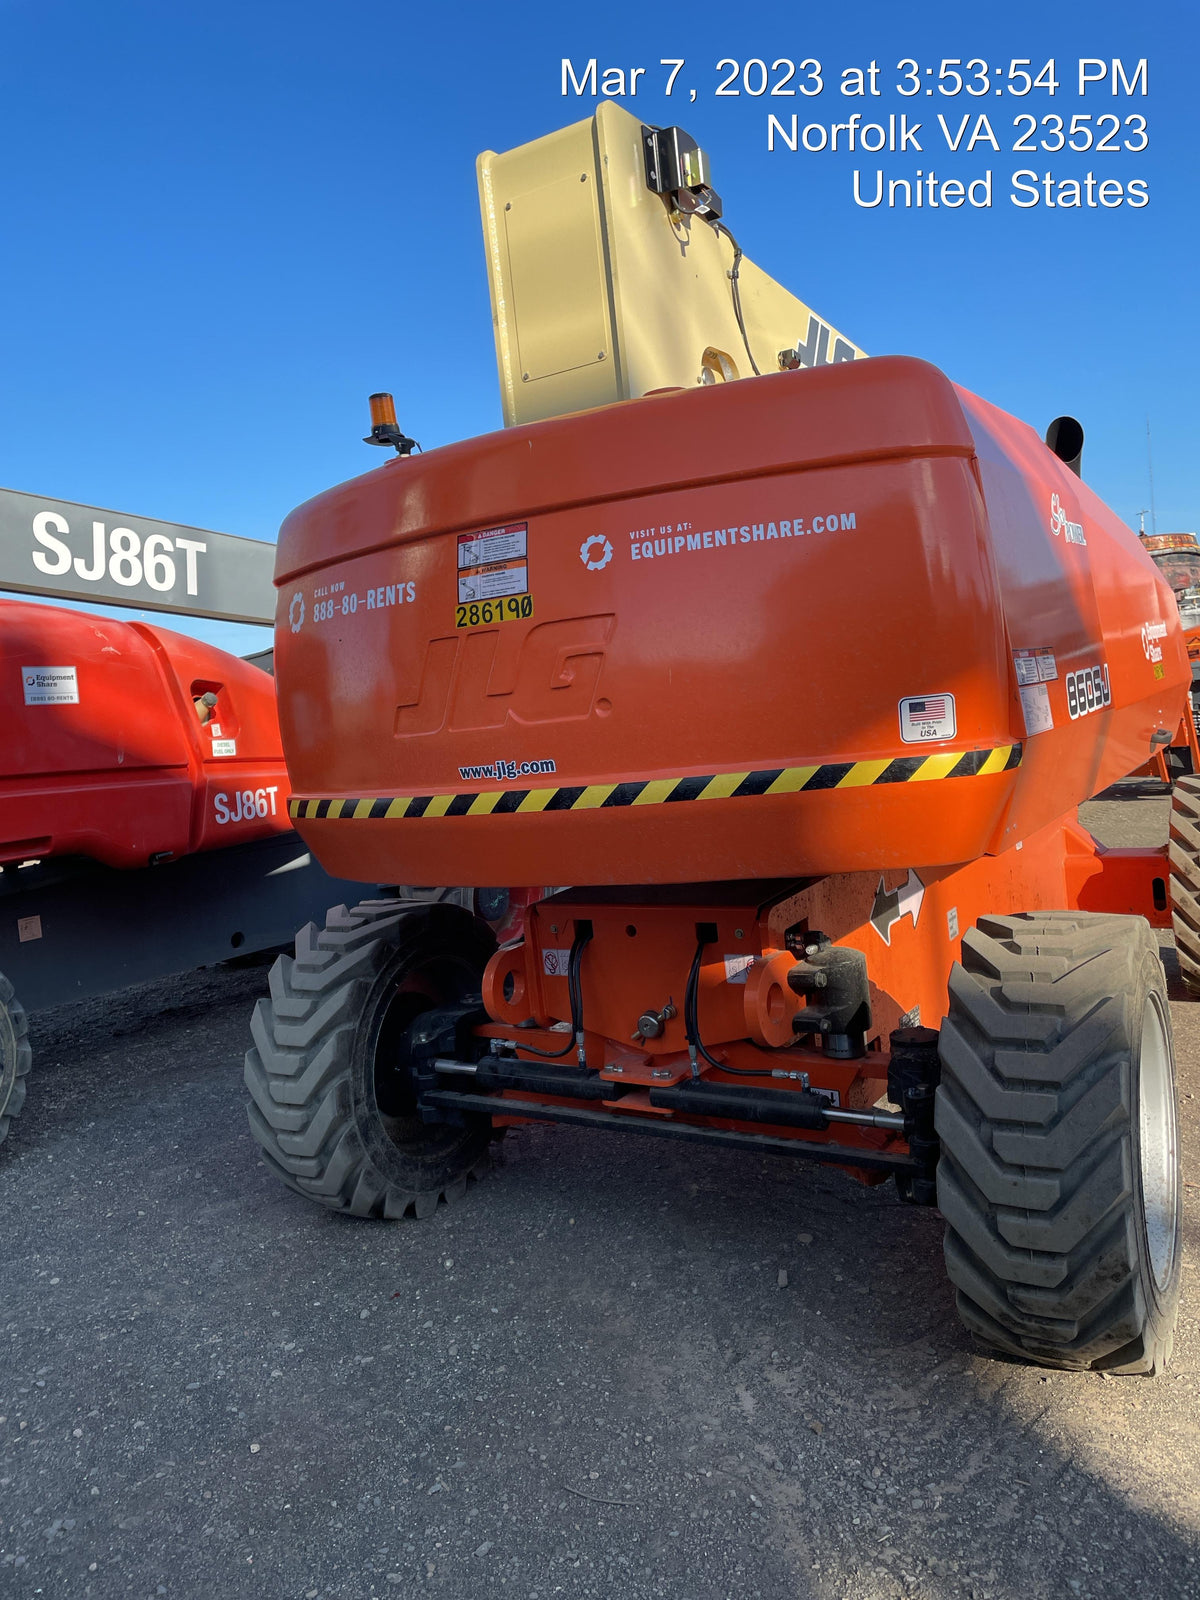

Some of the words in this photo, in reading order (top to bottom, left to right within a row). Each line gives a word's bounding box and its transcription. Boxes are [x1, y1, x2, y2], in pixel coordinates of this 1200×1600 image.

[629, 527, 656, 539] VISIT
[660, 525, 672, 534] US
[676, 522, 692, 531] AT:
[630, 512, 857, 560] EQUIPMENTSHARE.COM
[32, 511, 206, 596] SJ86T
[313, 581, 416, 622] 888-80-RENTS
[314, 588, 329, 598] CALL
[331, 581, 345, 592] NOW
[456, 595, 533, 628] 286190
[393, 613, 616, 739] JLG
[920, 729, 937, 737] USA
[460, 759, 555, 780] www.jlg.com
[213, 786, 278, 825] SJ86T
